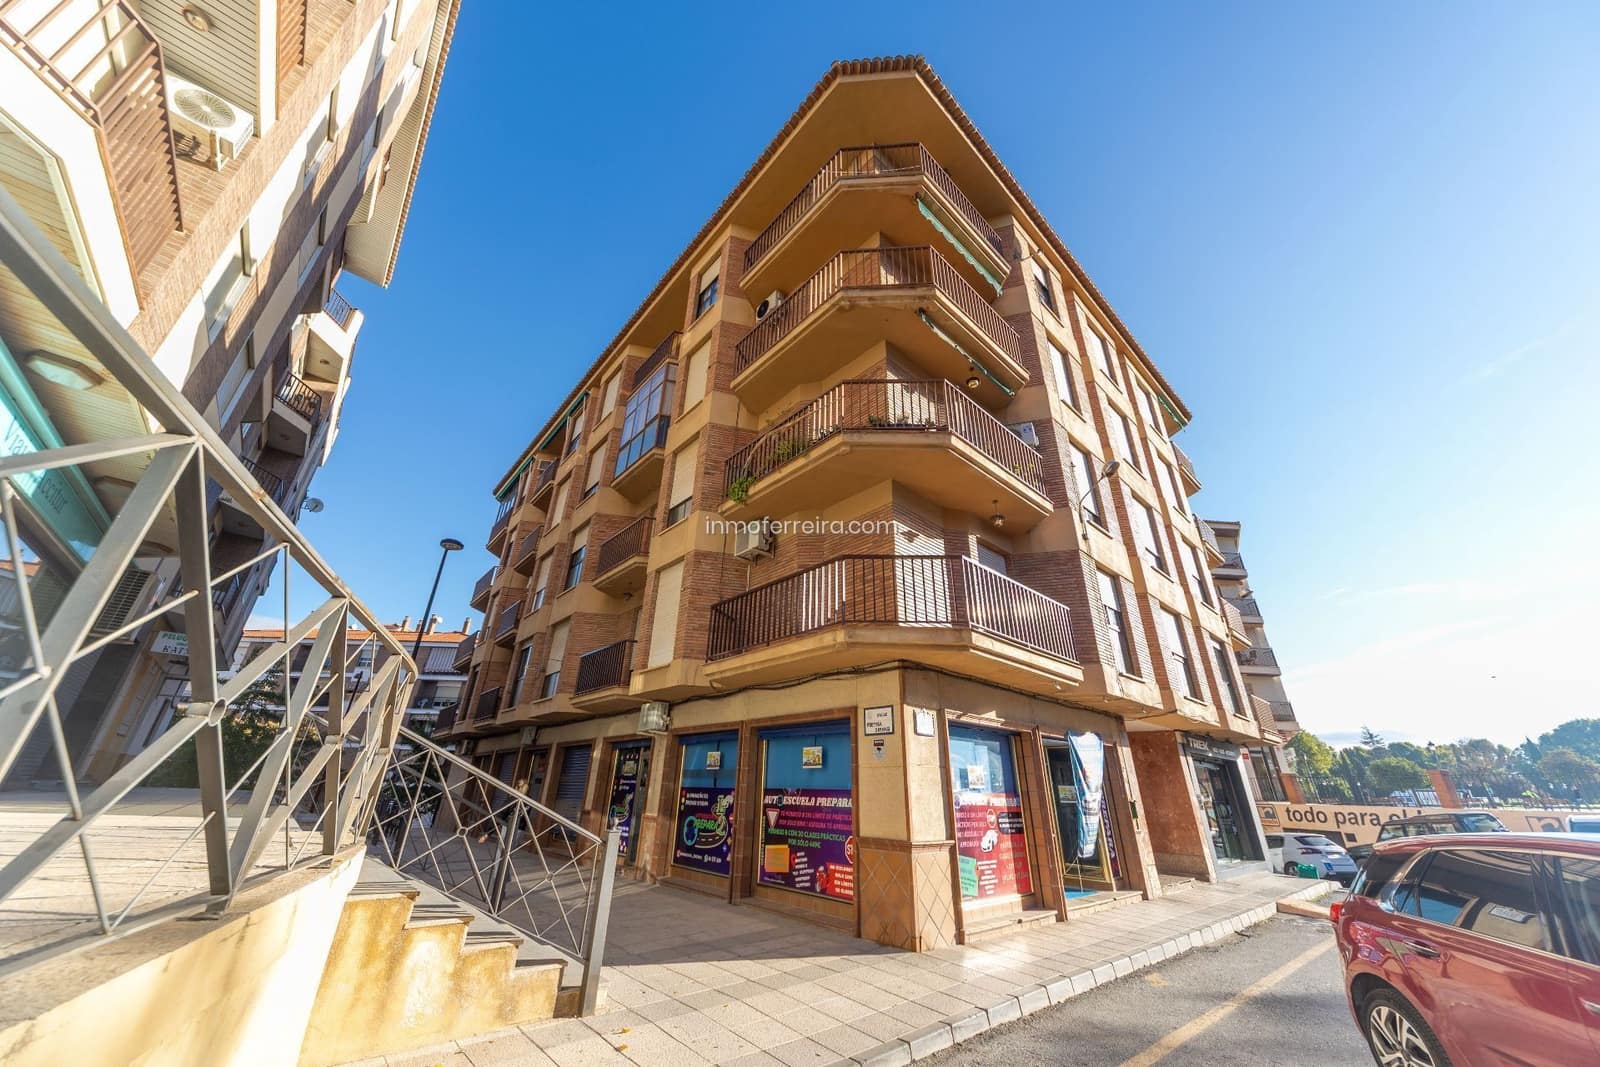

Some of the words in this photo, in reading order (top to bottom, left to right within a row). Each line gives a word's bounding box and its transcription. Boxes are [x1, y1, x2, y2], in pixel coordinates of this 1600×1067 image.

[763, 794, 815, 807] AUTOESCUELA
[1285, 806, 1328, 824] todo
[1334, 809, 1382, 828] para
